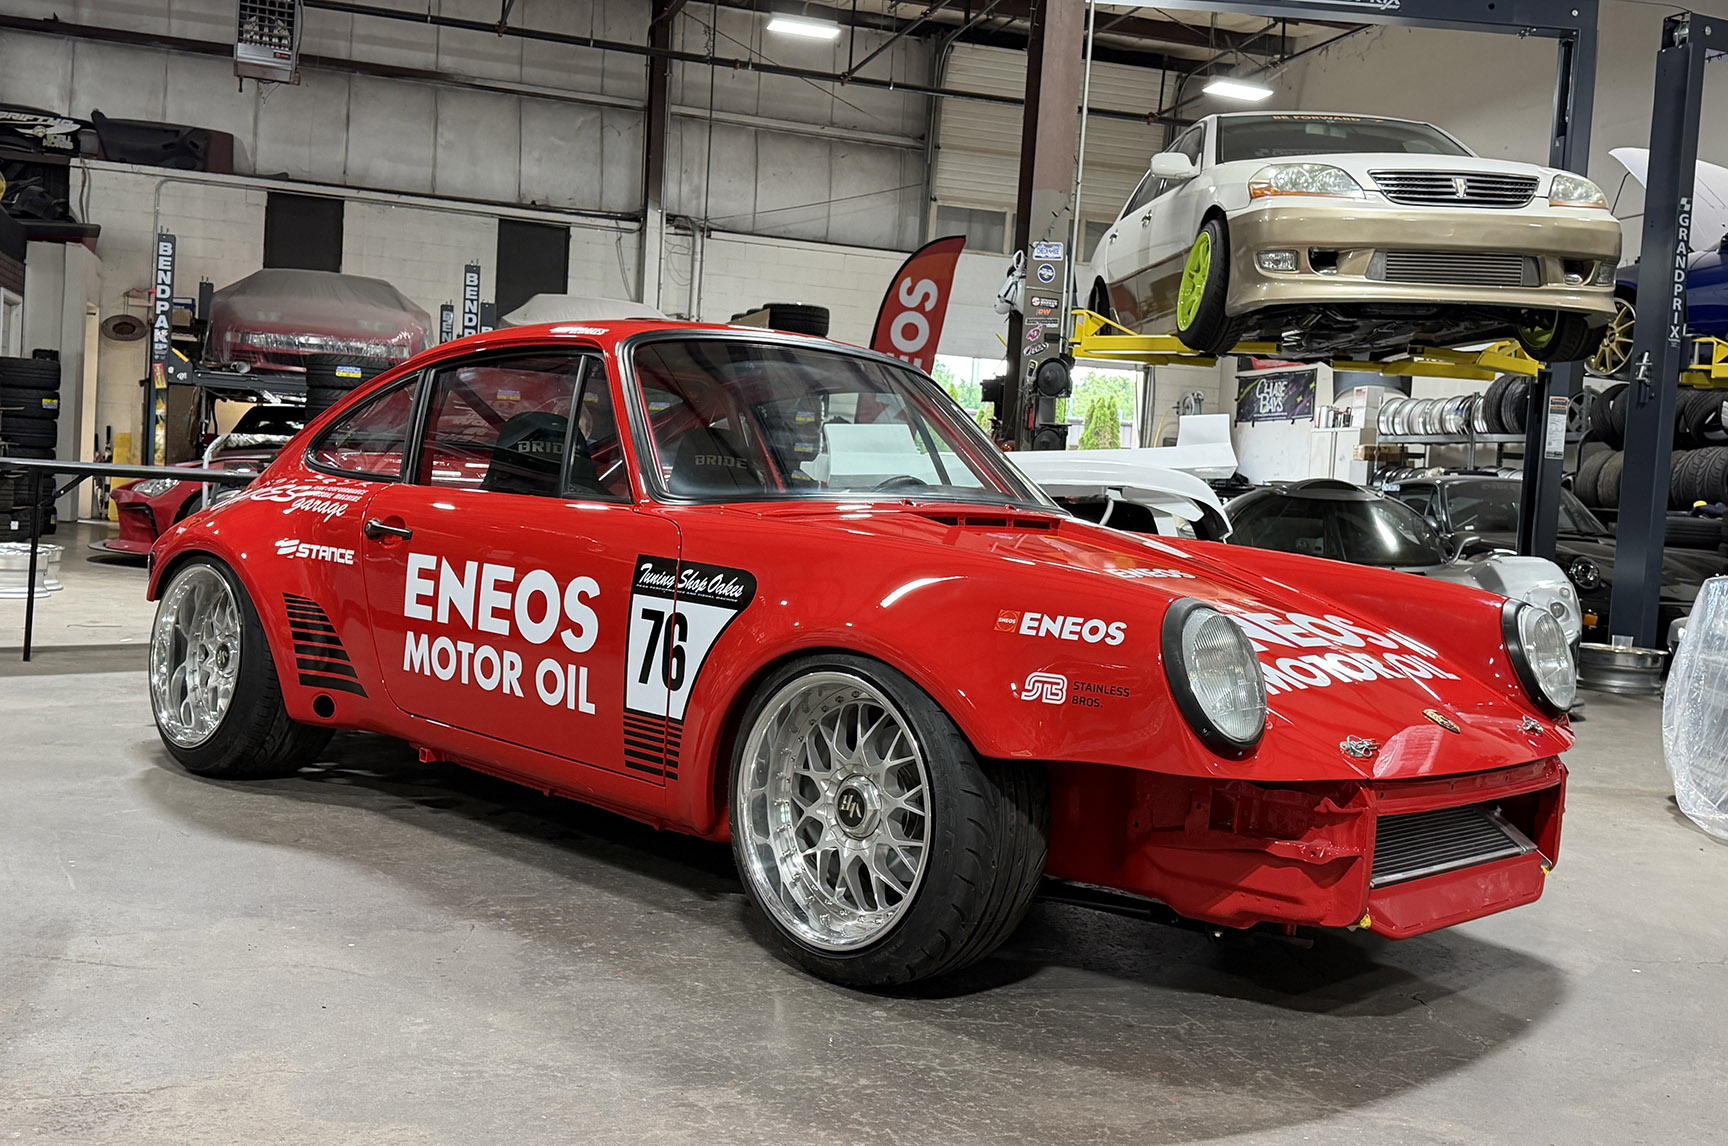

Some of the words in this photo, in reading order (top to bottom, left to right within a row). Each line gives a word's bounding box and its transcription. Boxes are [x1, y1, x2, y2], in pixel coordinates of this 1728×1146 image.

[1668, 213, 1691, 339] GRANDPRIX
[153, 241, 174, 343] BENDPAK
[1259, 394, 1284, 413] BAYS
[517, 440, 580, 457] BRID
[694, 454, 748, 470] BRIDE
[282, 497, 349, 523] garage
[295, 543, 355, 565] STANCE
[639, 562, 677, 589] Tuning
[677, 568, 708, 593] Shop
[707, 573, 745, 598] Oakes
[404, 552, 601, 654] ENEOS
[1019, 611, 1128, 646] ENEOS
[638, 607, 689, 692] 76
[403, 630, 525, 698] MOTOR
[535, 658, 596, 715] OIL
[1072, 695, 1104, 709] BROS.
[1073, 681, 1130, 698] STAINLESS
